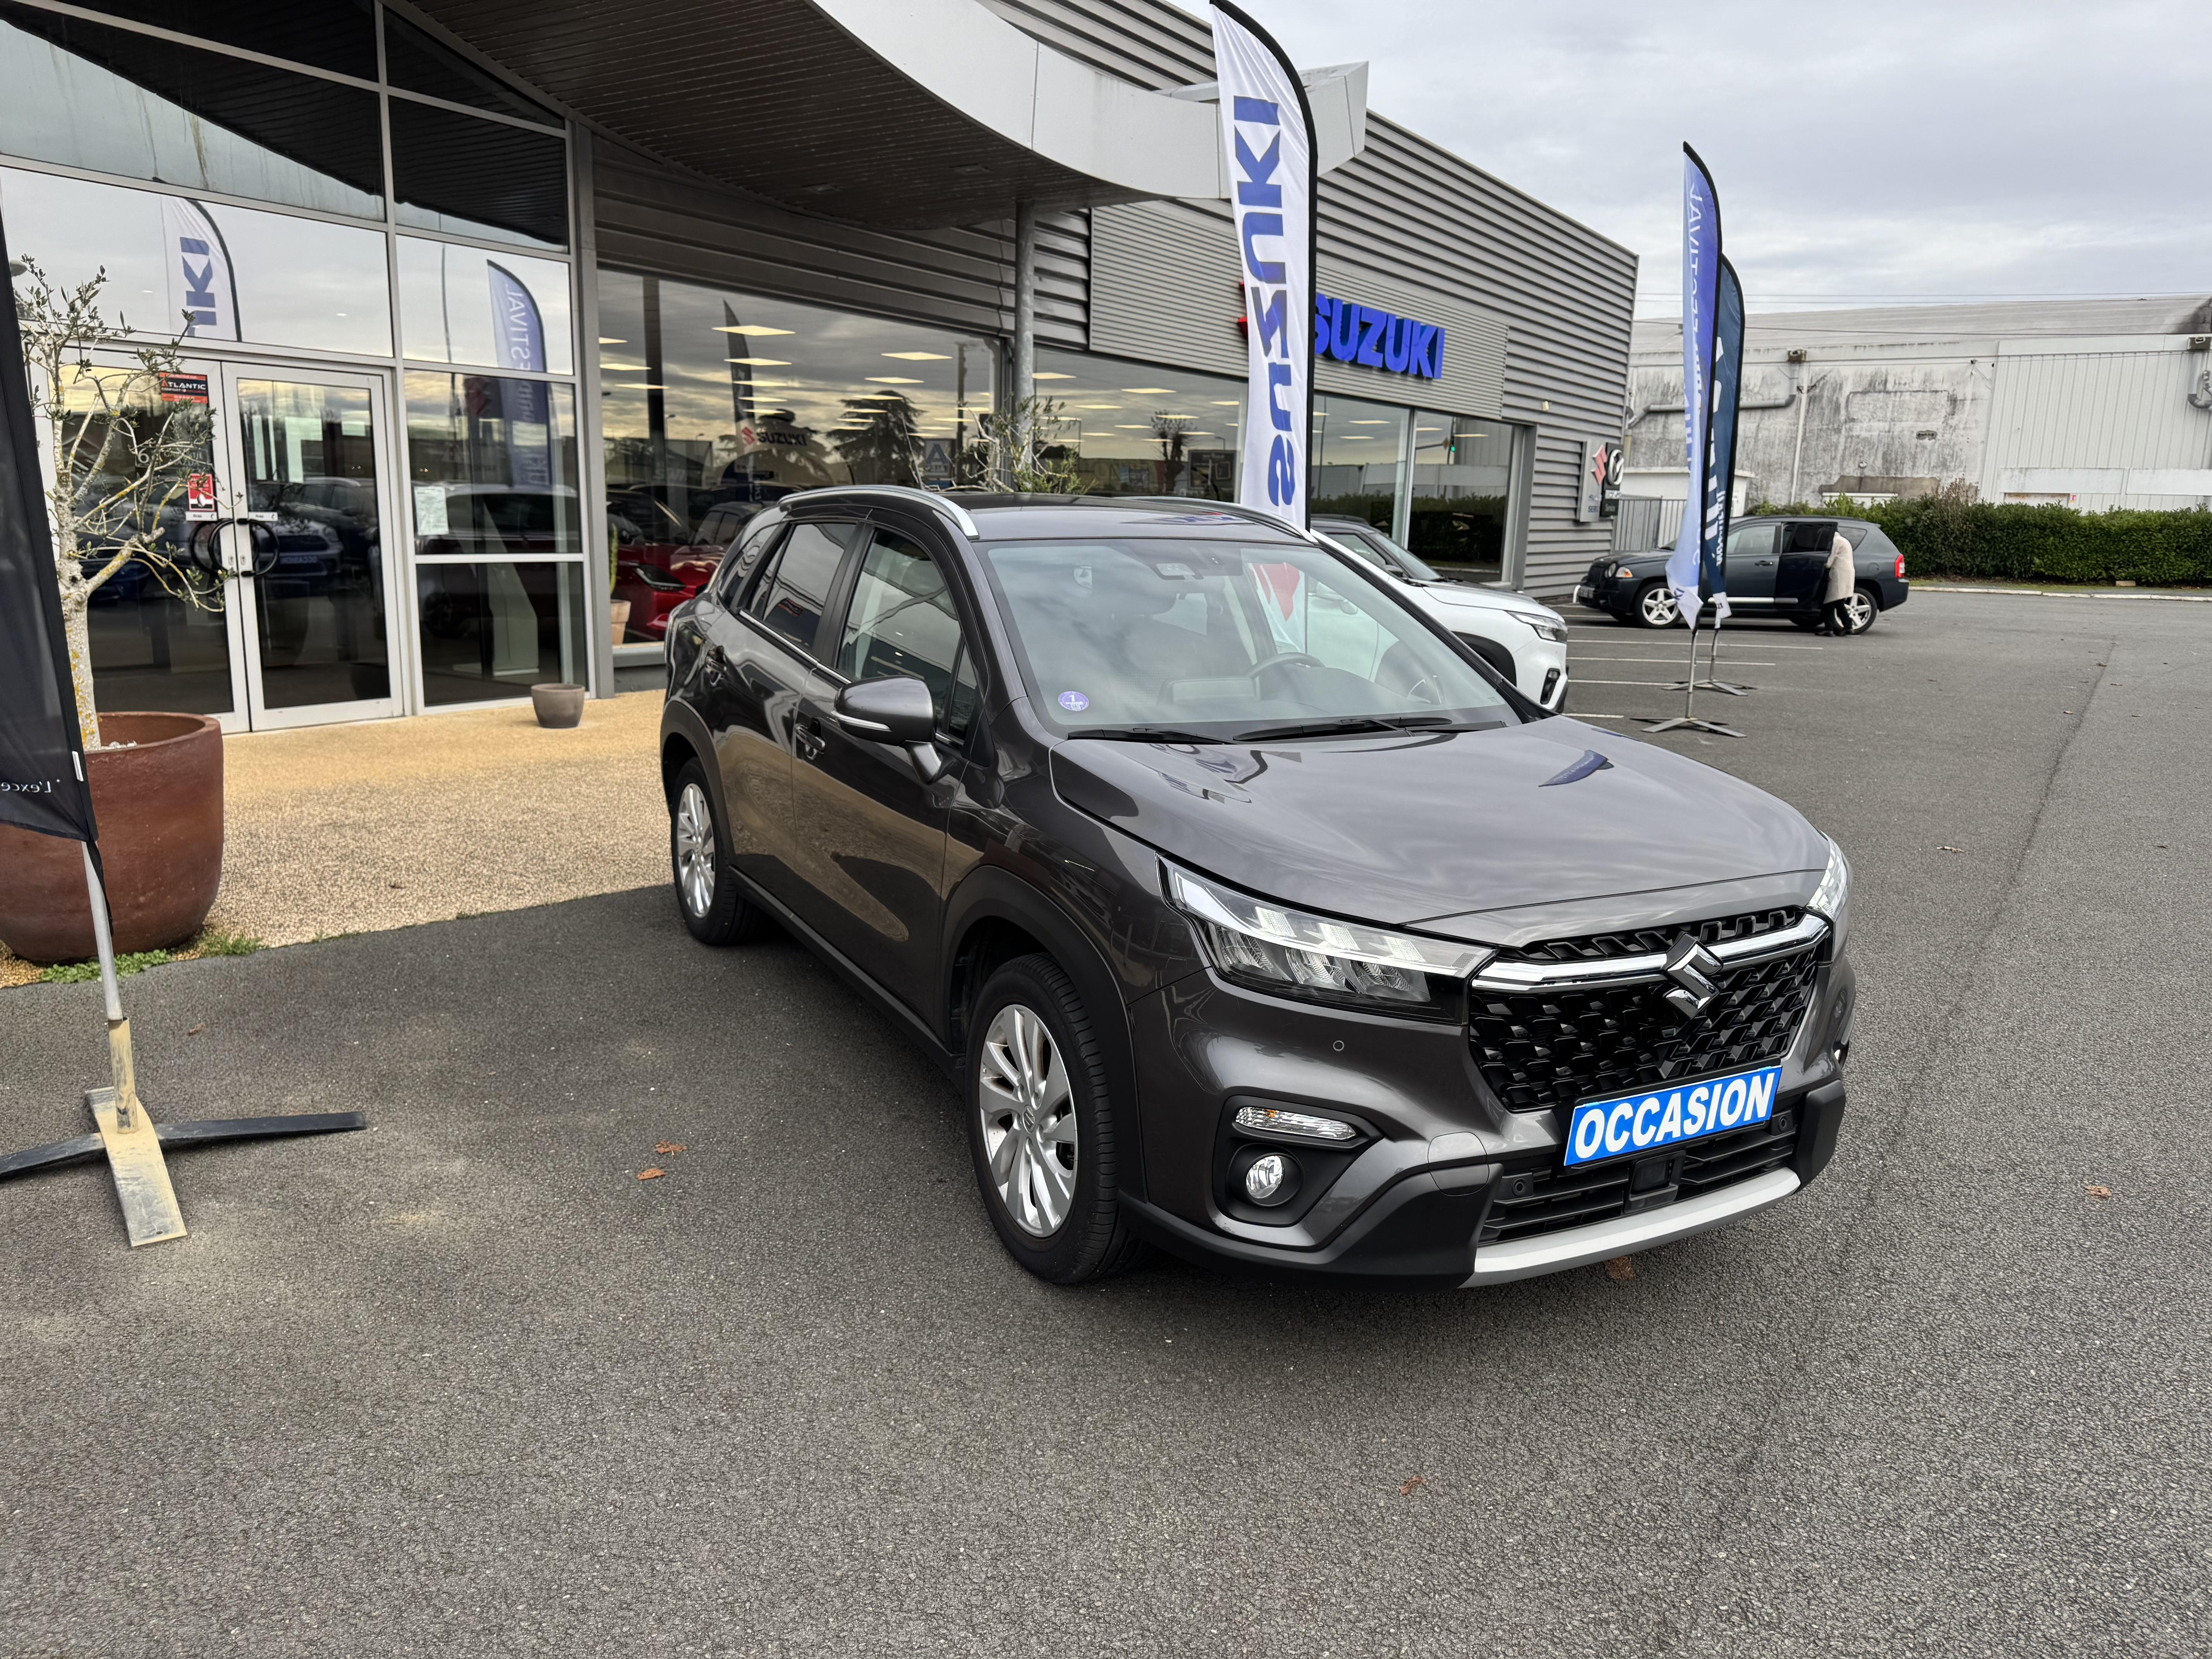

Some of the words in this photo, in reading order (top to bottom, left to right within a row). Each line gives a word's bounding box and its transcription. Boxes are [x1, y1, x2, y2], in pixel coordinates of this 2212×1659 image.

[161, 379, 206, 390] ATLANTIC
[756, 432, 807, 446] SUZUKI
[1575, 1072, 1775, 1158] OCCASION
